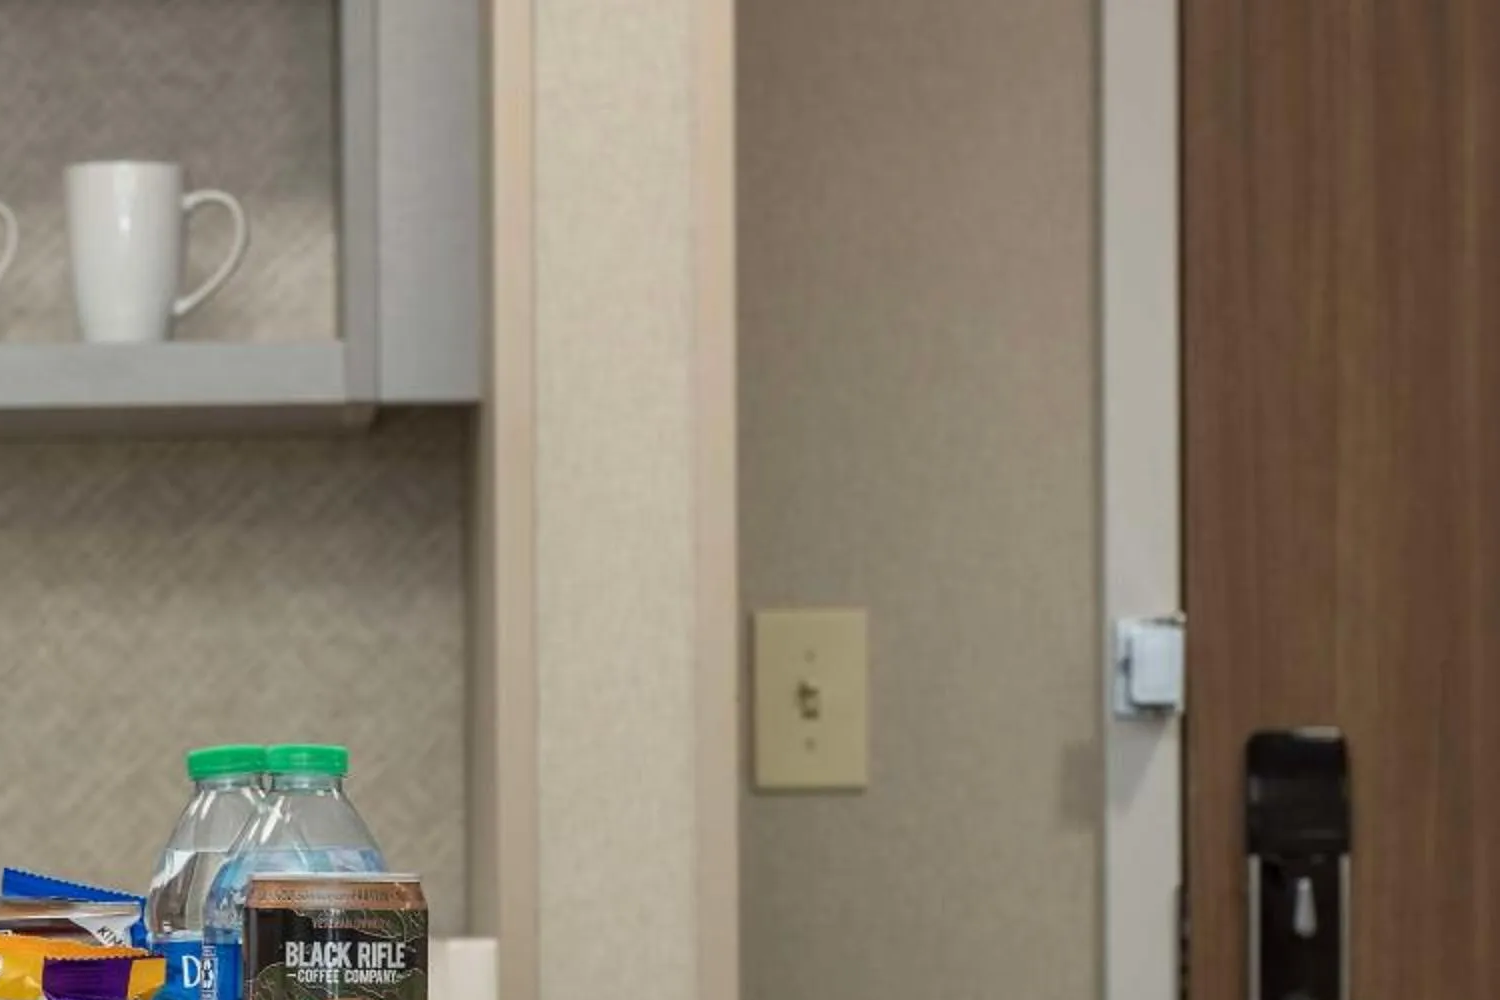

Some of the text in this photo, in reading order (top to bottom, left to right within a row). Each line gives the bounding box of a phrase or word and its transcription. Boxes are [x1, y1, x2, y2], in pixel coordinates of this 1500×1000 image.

[285, 941, 406, 969] BLACK RIFLE
[297, 969, 397, 984] COFFEE COMPANY
